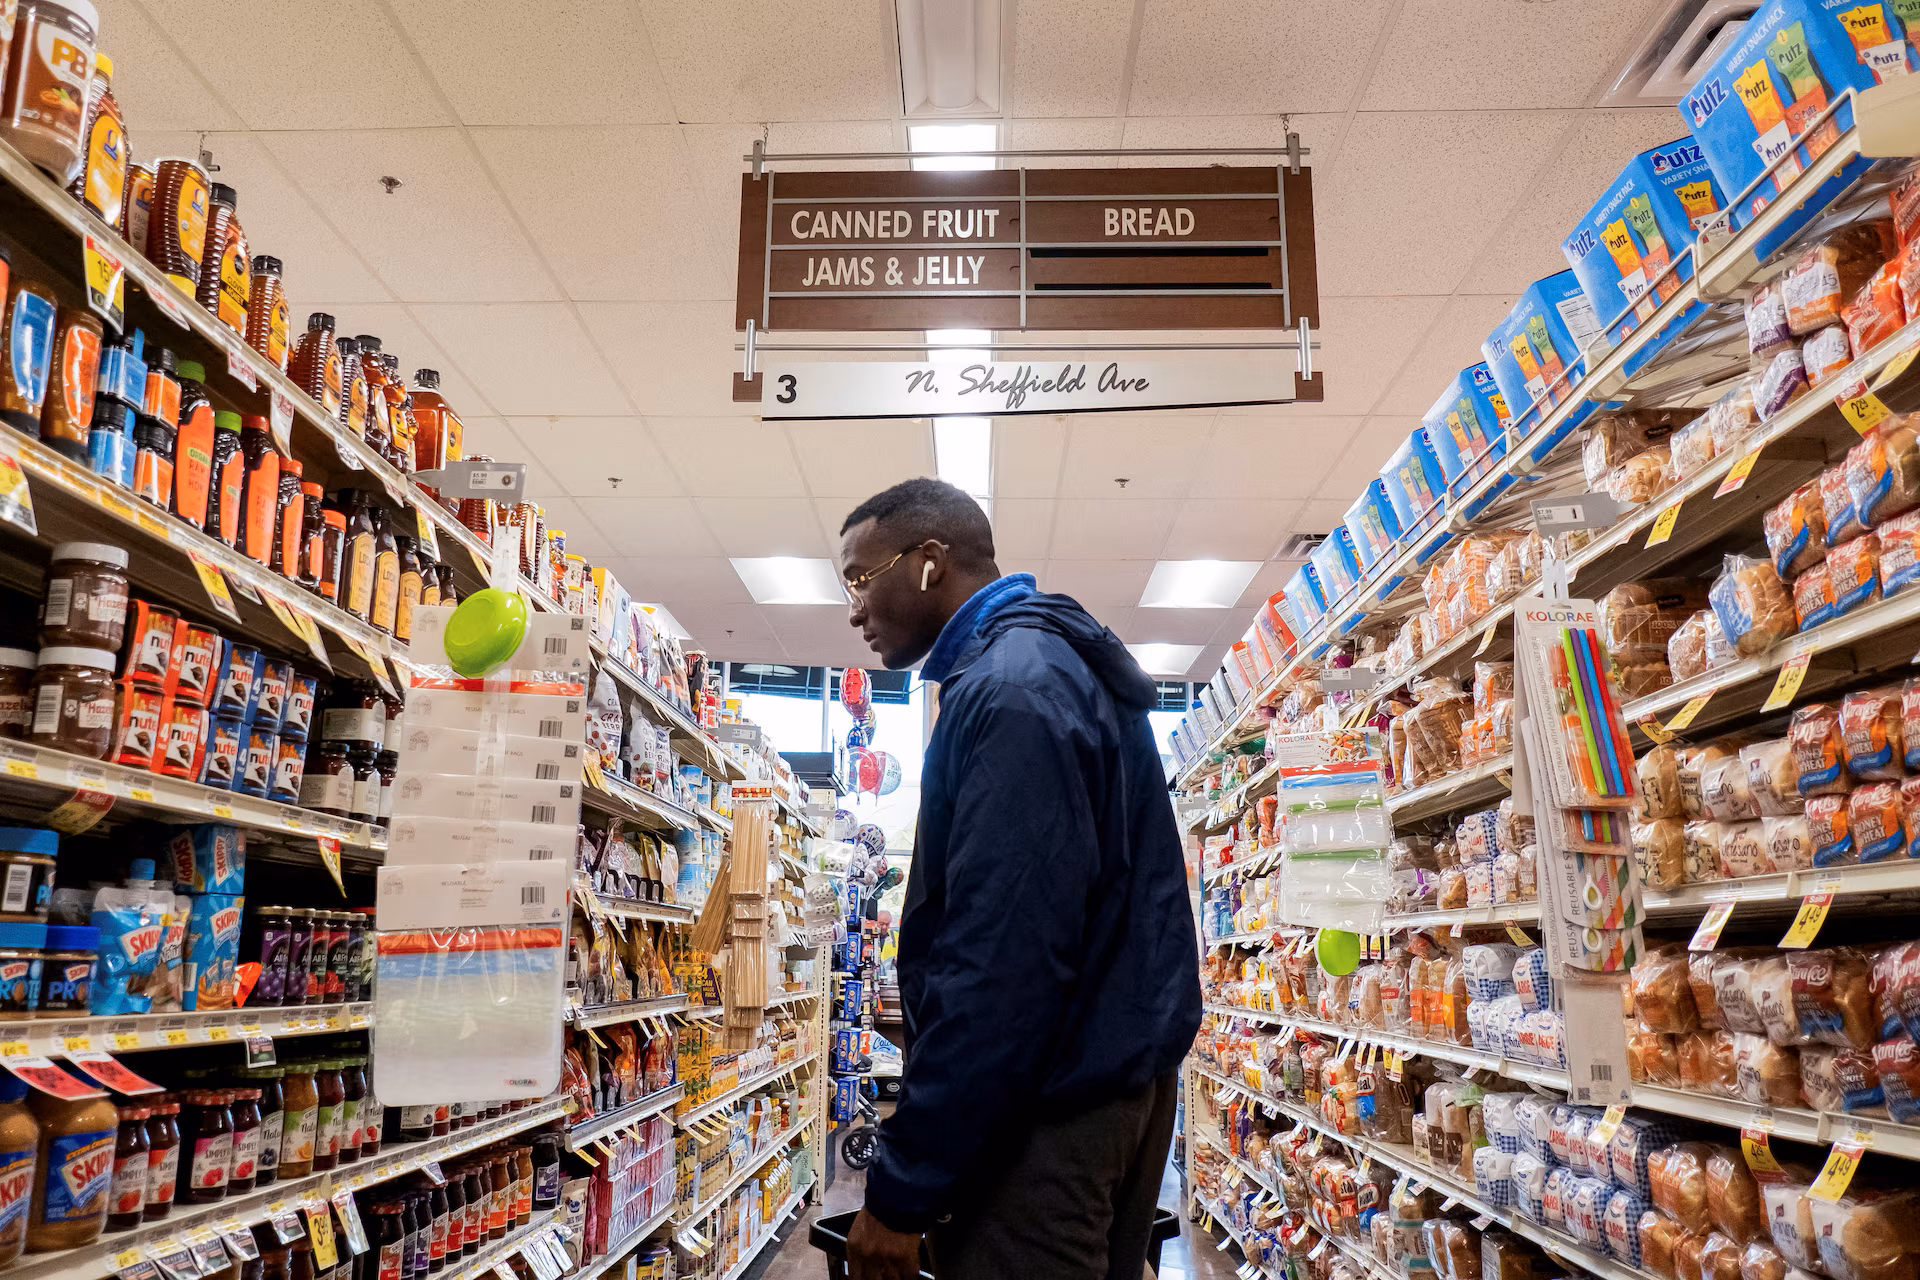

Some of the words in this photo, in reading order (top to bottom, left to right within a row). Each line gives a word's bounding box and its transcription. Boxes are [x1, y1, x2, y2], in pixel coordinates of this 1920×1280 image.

[1660, 168, 1693, 186] VARIETY
[1692, 163, 1711, 175] SNA
[791, 210, 912, 239] CANNED
[922, 208, 999, 239] FRUIT
[1104, 207, 1195, 237] BREAD
[802, 257, 875, 287] JAMS
[885, 258, 904, 286] &
[912, 256, 985, 286] JELLY
[1563, 287, 1584, 297] VARIET
[776, 374, 798, 404] 3
[905, 369, 941, 395] N.
[957, 363, 1088, 409] Sheffield
[1097, 362, 1150, 393] Ave
[1526, 611, 1595, 622] KOLORAE
[173, 645, 182, 663] 4
[253, 678, 261, 695] 4
[160, 724, 169, 742] 4
[1279, 735, 1316, 744] KOLORAE
[239, 749, 247, 765] 4
[176, 837, 194, 883] SKIPPY
[217, 838, 226, 879] SKIPPY
[1567, 864, 1580, 915] REUSABLE
[215, 910, 239, 934] SKIPPY
